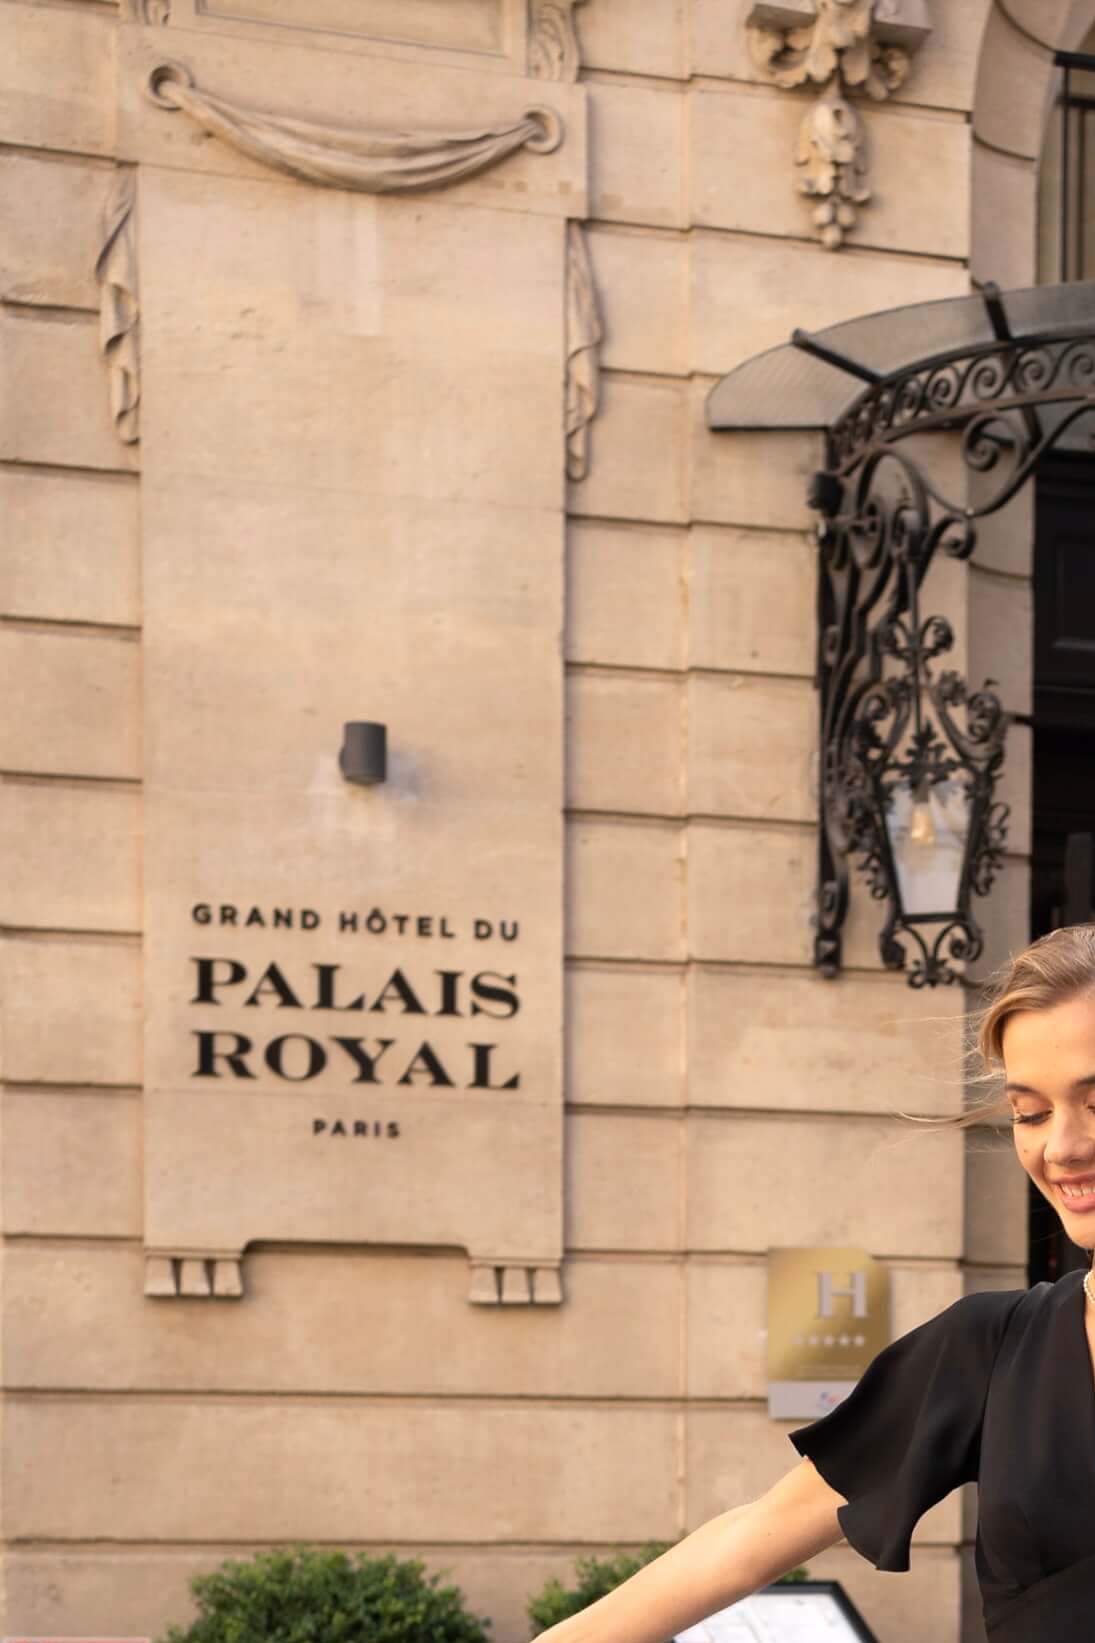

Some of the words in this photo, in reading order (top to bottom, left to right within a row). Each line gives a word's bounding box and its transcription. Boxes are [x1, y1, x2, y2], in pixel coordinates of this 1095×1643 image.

[191, 903, 321, 931] GRAND
[339, 907, 456, 939] HÔTEL
[473, 919, 519, 941] DU
[189, 956, 520, 1020] PALAIS
[190, 1029, 521, 1091] ROYAL
[313, 1118, 401, 1138] PARIS
[818, 1270, 867, 1318] H
